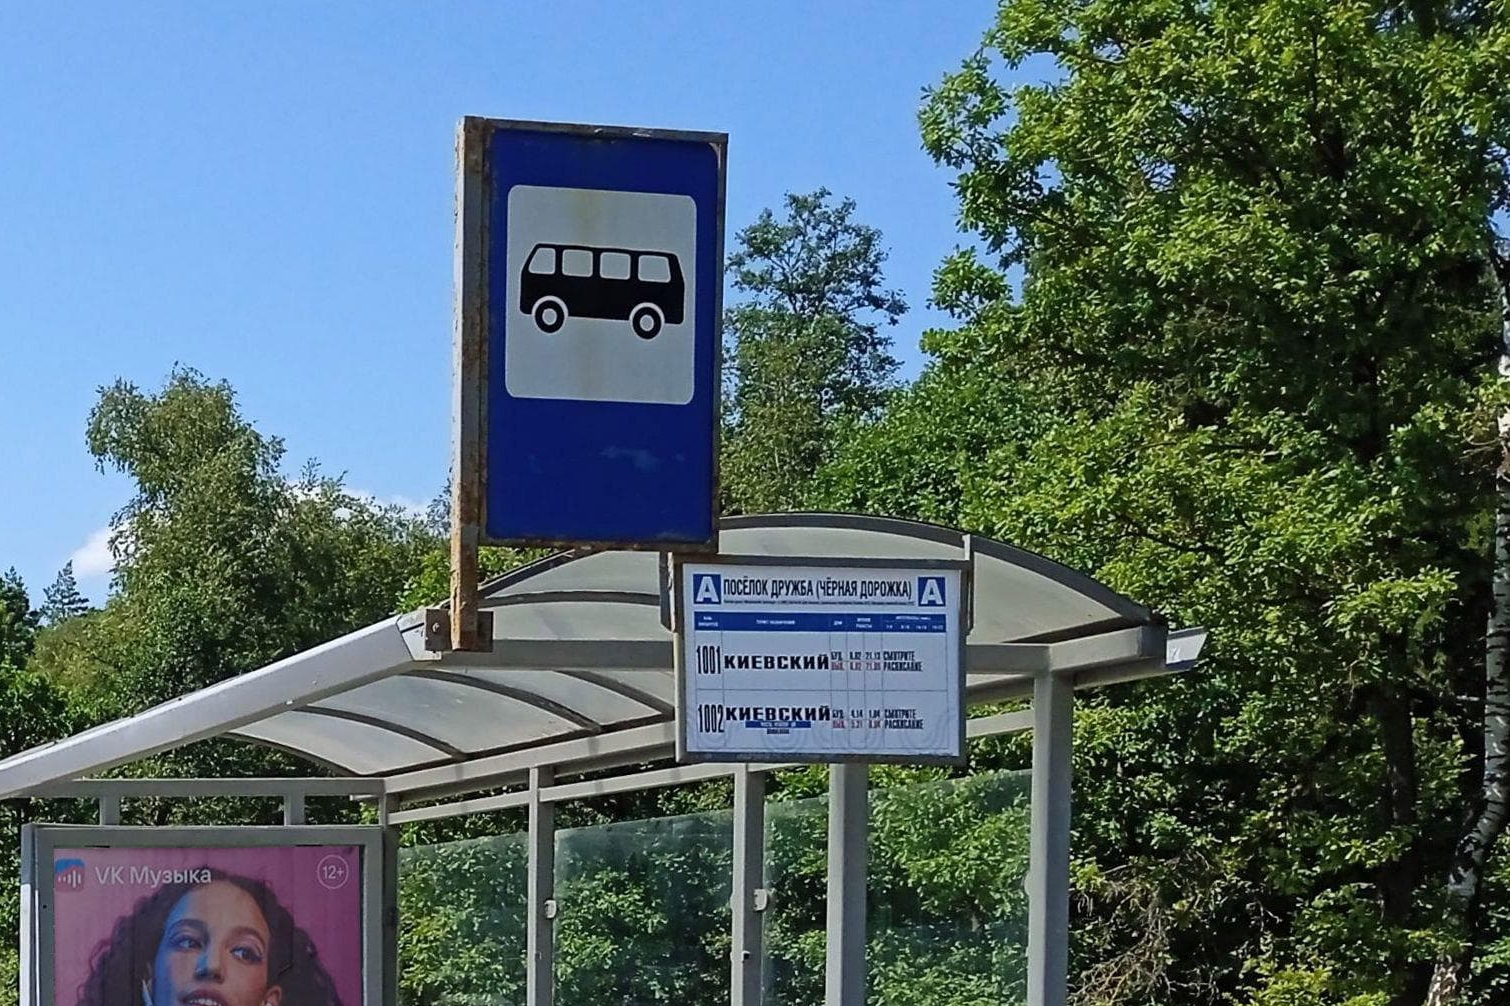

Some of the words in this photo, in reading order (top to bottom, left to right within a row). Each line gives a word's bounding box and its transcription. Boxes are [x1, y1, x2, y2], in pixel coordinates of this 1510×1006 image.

[723, 575, 769, 596] ПОСЁЛОК
[771, 579, 814, 598] ДРУЖБА
[816, 576, 858, 600] (ЧЁРНАЯ
[860, 580, 912, 600] ДОРОЖКА)
[696, 645, 721, 674] 1001
[724, 653, 829, 669] КИЕВСКИЙ
[698, 704, 725, 733] 1002
[726, 705, 831, 721] КИЕВСКИЙ
[94, 866, 124, 885] VK
[130, 865, 212, 889] Музыка
[322, 864, 344, 879] 12+
